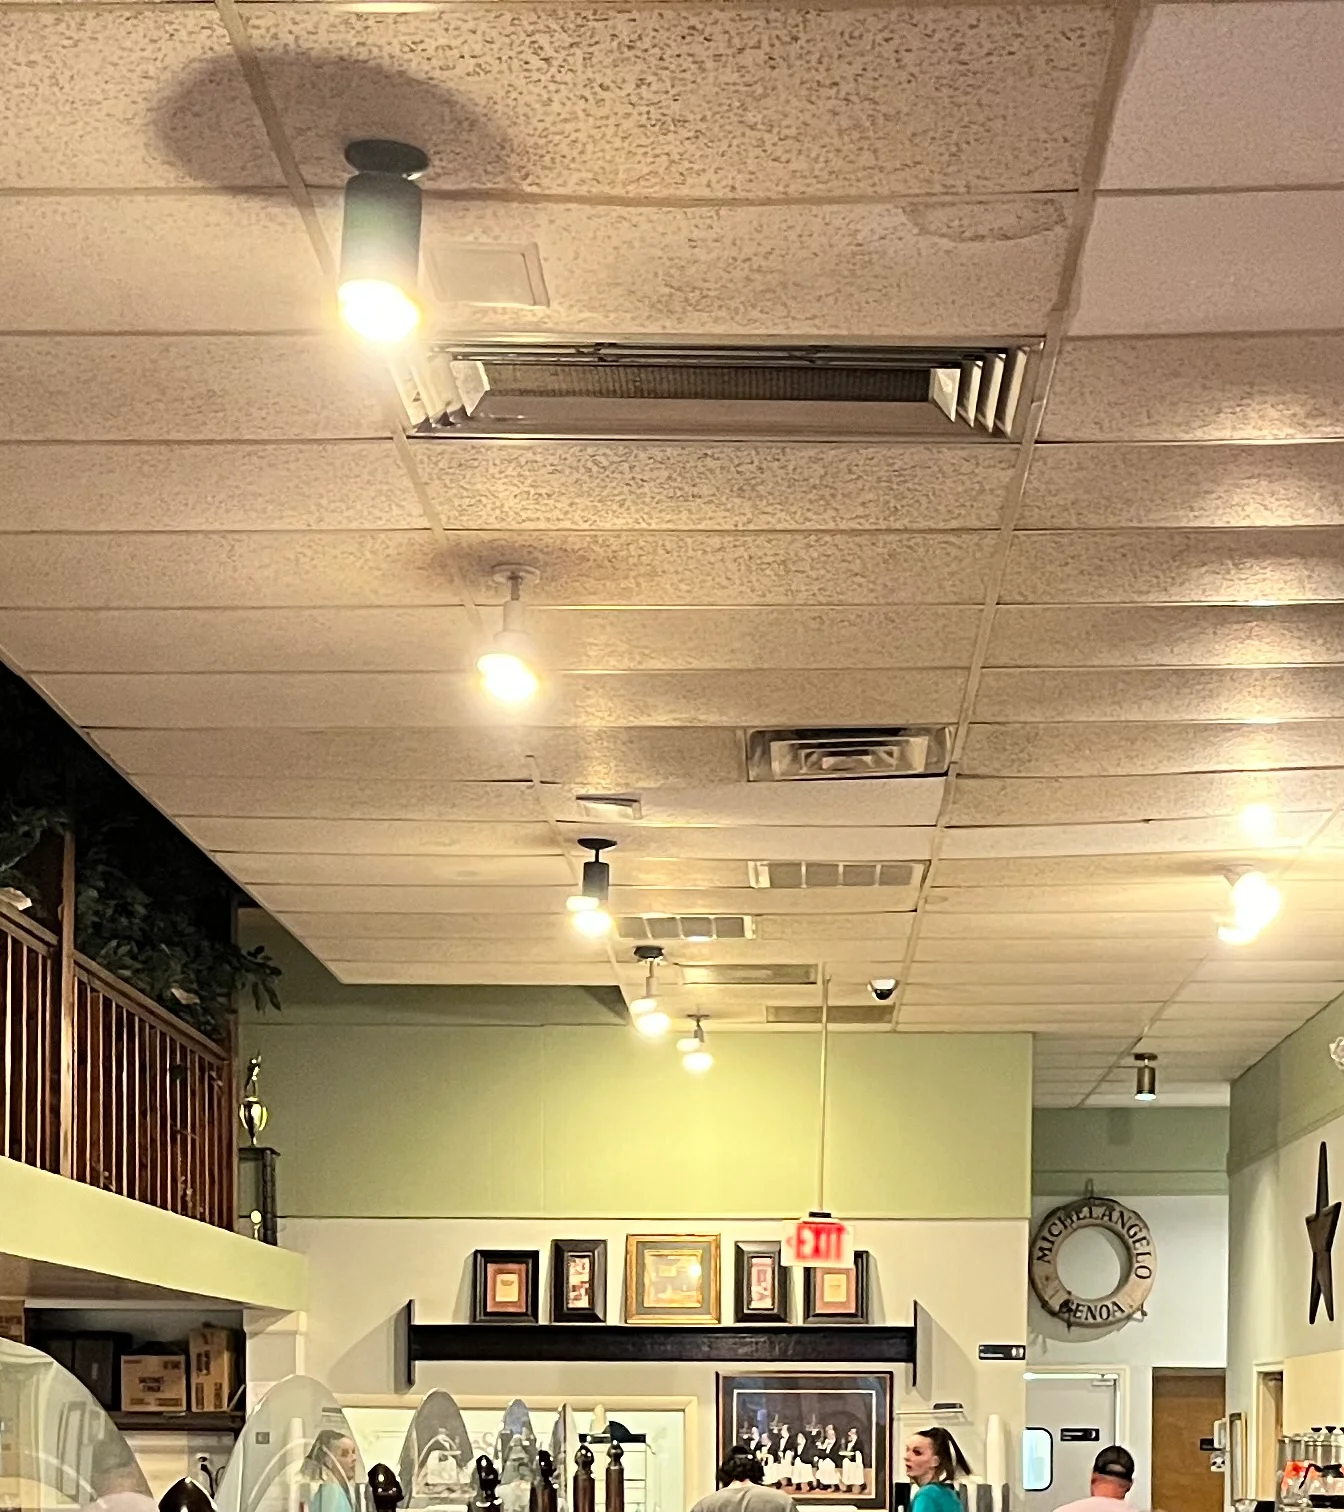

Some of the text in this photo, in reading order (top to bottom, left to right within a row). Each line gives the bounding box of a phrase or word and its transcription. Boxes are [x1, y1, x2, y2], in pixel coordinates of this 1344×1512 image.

[796, 1223, 845, 1261] EXIT
[1036, 1203, 1152, 1280] MICHELANGELO
[1058, 1299, 1126, 1322] GENOA
